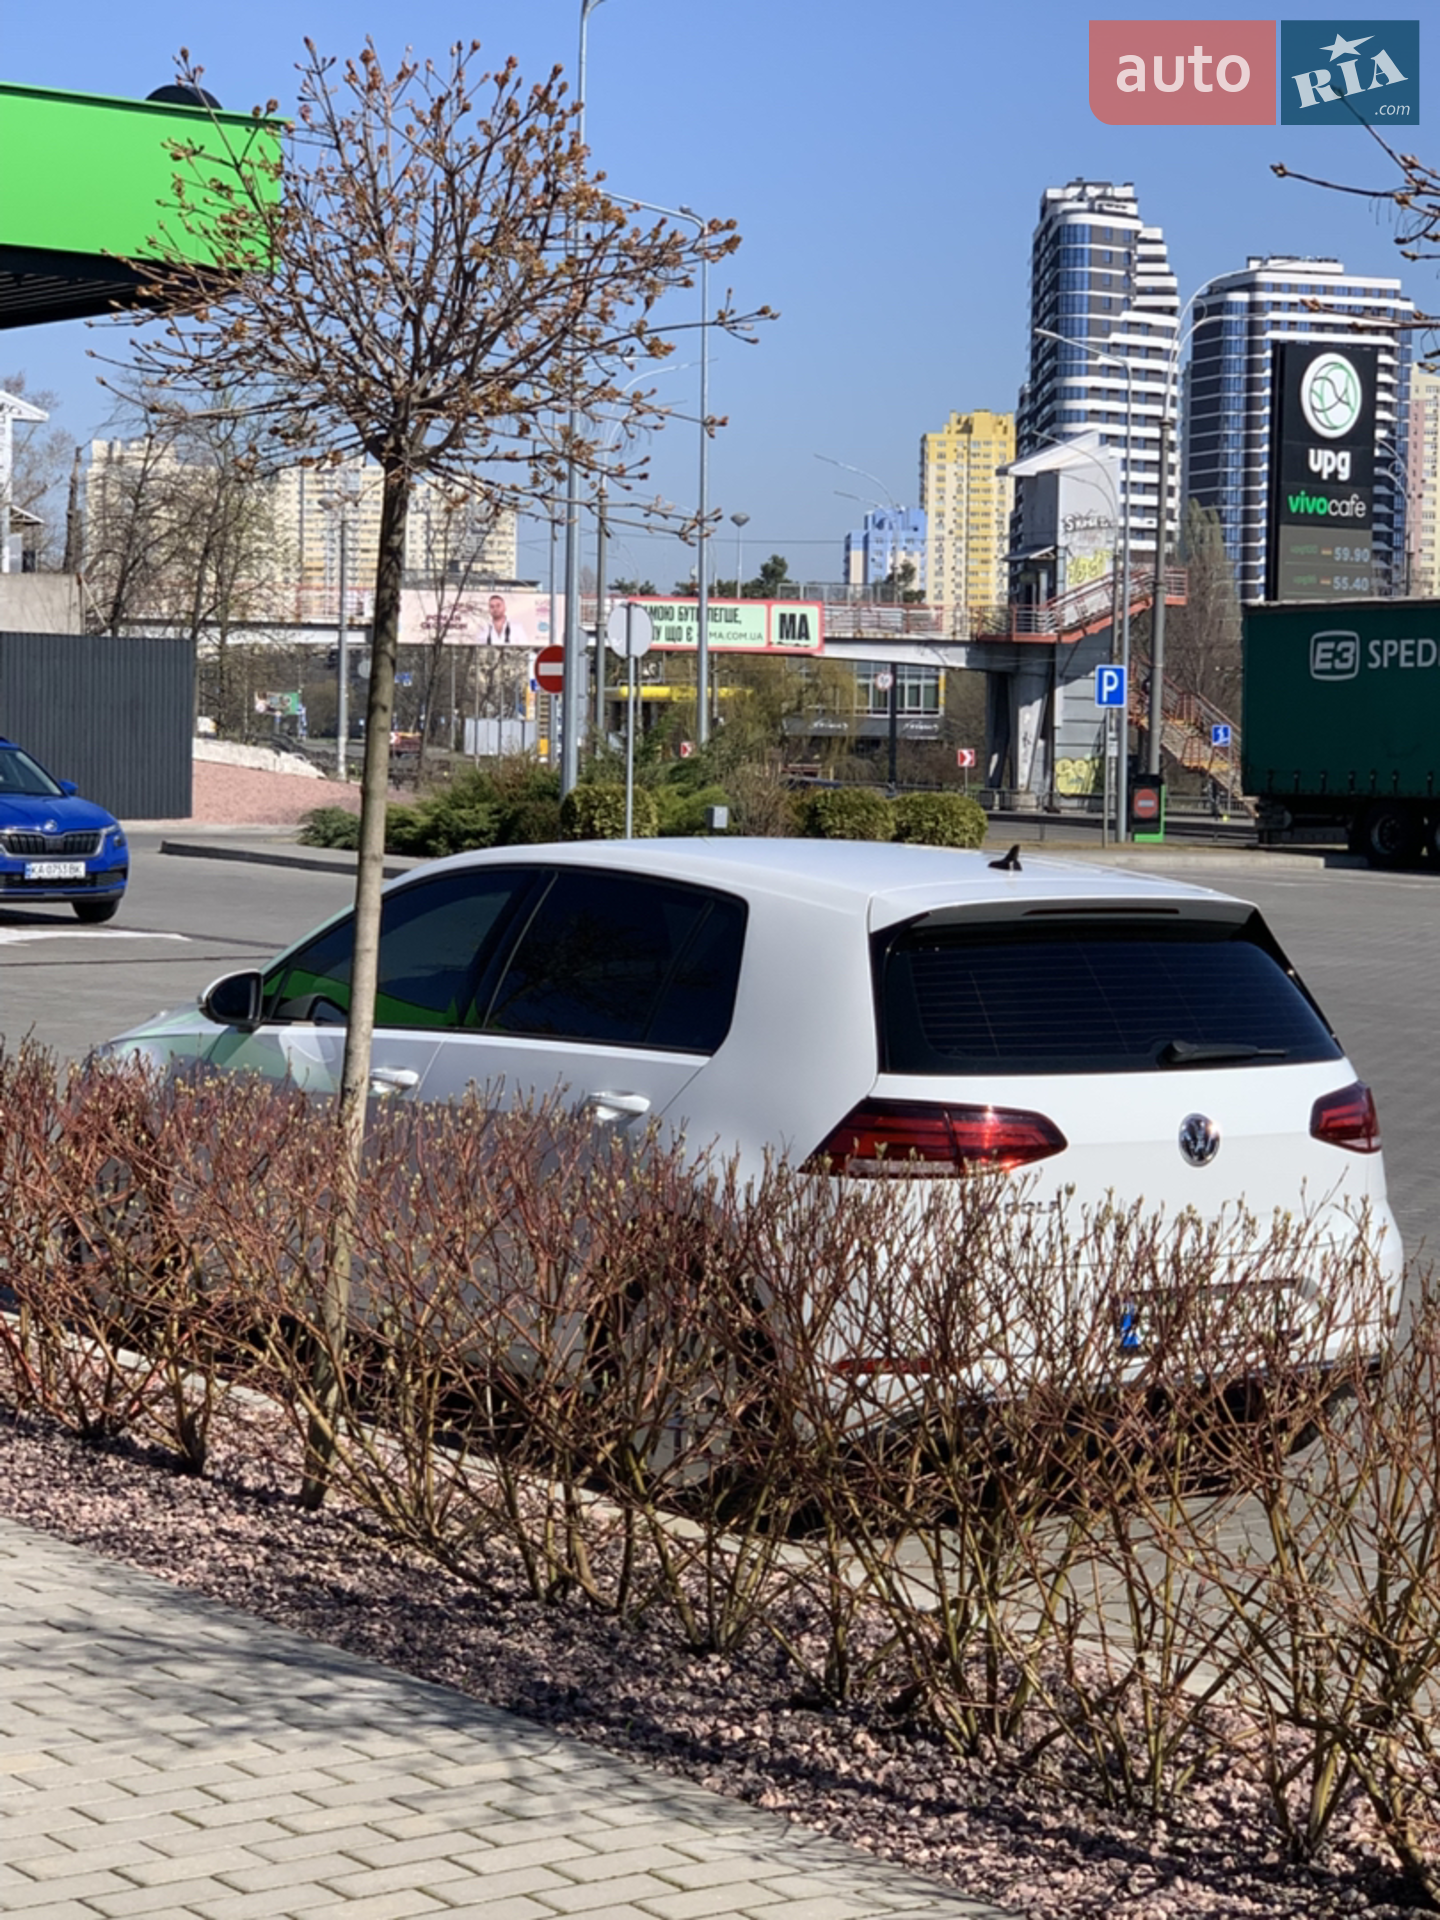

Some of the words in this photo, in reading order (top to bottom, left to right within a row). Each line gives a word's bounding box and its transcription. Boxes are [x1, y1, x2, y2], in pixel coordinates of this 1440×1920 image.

[1308, 448, 1351, 481] upg
[1333, 576, 1370, 591] 55.40
[1315, 641, 1356, 670] E3
[1367, 638, 1440, 669] SPED
[1102, 670, 1119, 703] P
